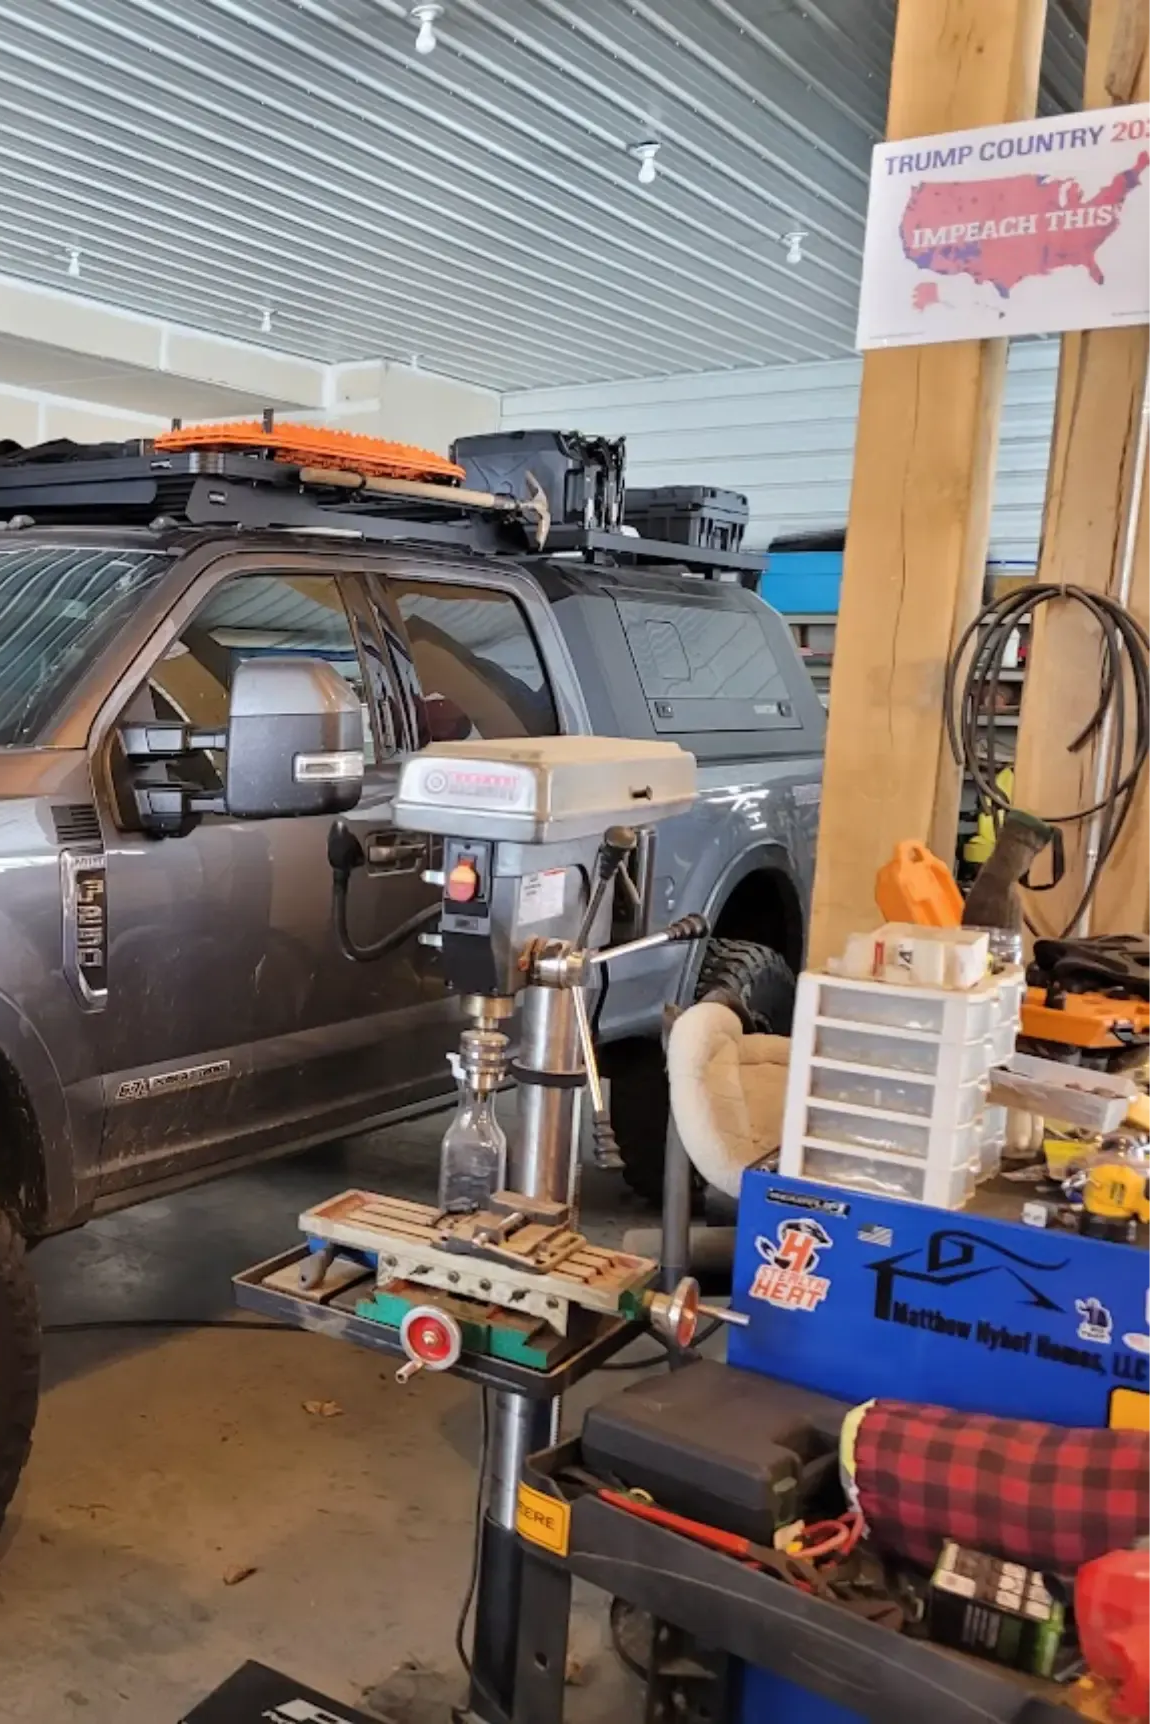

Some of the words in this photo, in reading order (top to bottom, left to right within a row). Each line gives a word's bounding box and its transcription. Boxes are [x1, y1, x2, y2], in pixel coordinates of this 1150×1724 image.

[885, 145, 973, 176] TRUMP
[978, 125, 1105, 162] COUNTRY
[912, 213, 1038, 250] IMPEACH
[1045, 203, 1113, 233] THIS
[754, 1279, 822, 1308] HEAT
[760, 1265, 828, 1291] STEALTH
[892, 1300, 973, 1341] Matthew
[1112, 1351, 1148, 1382] LLC
